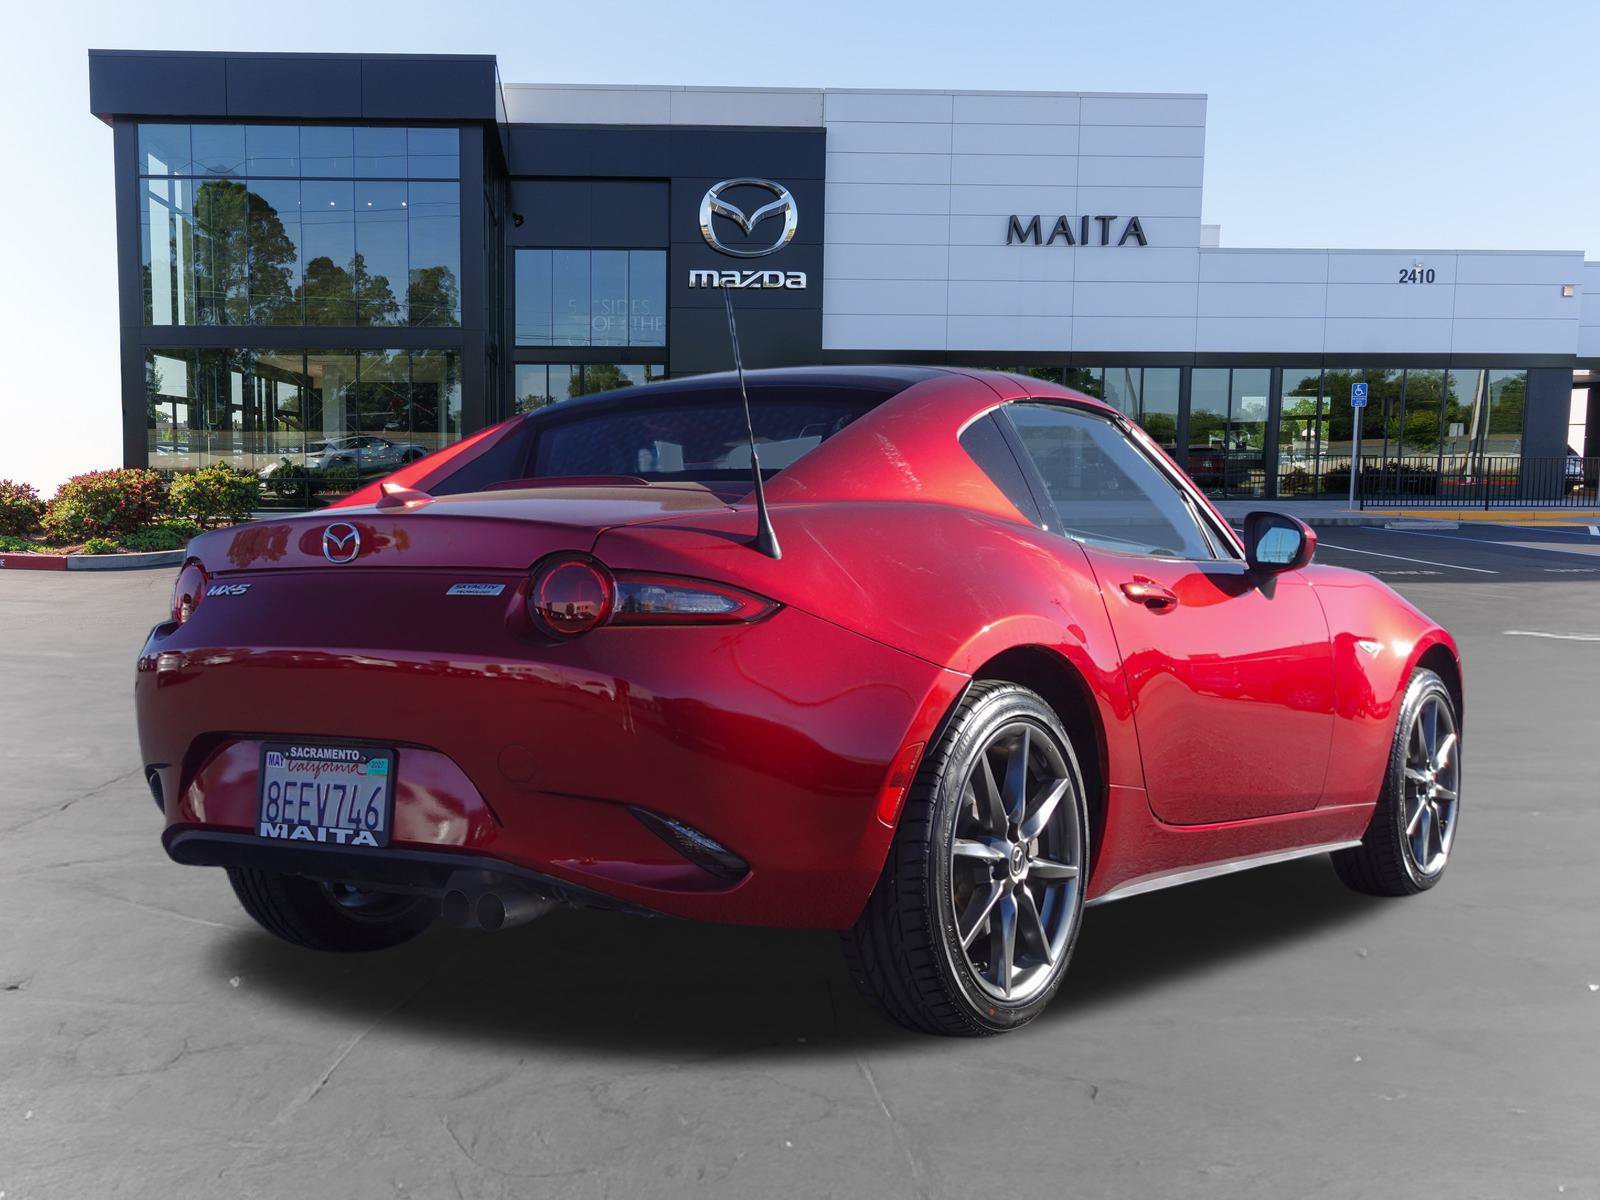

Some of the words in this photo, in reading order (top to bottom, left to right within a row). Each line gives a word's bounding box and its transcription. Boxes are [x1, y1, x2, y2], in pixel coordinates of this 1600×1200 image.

[1006, 214, 1148, 246] MAITA
[1399, 269, 1435, 284] 2410
[290, 747, 360, 761] SACRAMENTO
[288, 759, 367, 780] California
[266, 780, 382, 831] 8EEV746
[260, 822, 379, 847] MAITA
